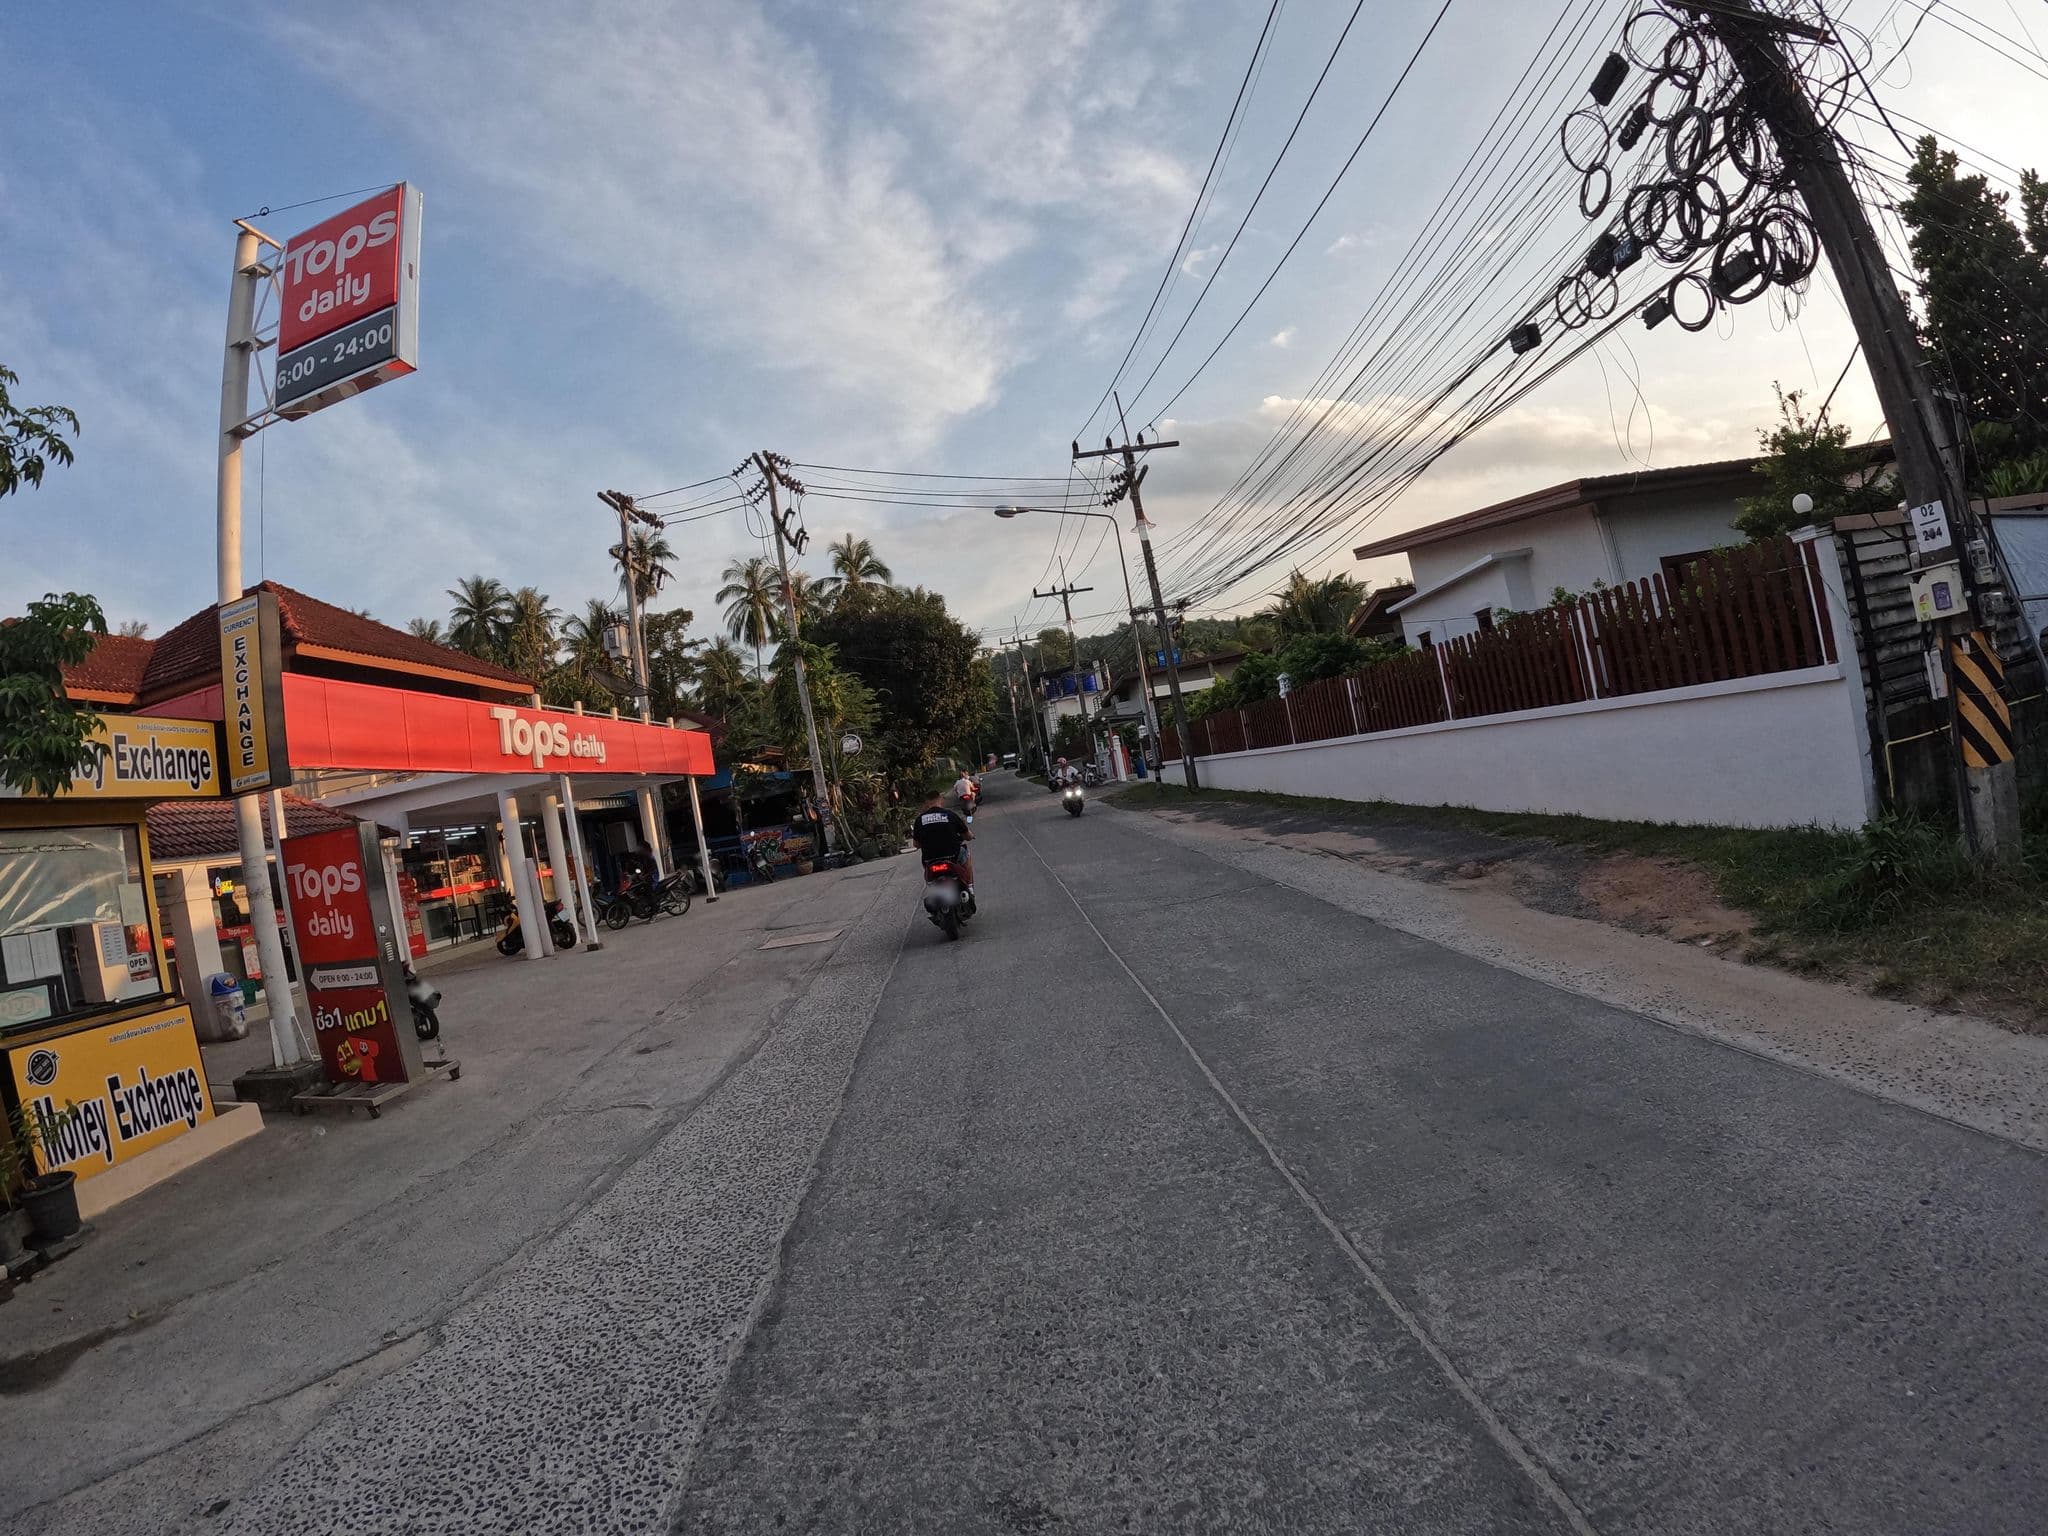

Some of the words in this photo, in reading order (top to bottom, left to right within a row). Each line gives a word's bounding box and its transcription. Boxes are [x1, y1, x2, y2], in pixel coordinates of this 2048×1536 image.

[287, 210, 397, 286] Tops
[299, 272, 370, 322] daily
[277, 355, 315, 390] 6:00
[334, 324, 392, 364] 24:00
[1921, 504, 1935, 517] 02
[224, 616, 256, 633] CURRENCY
[234, 637, 255, 767] EXCHANGE
[114, 735, 211, 789] Exchange
[490, 707, 570, 768] Tops
[572, 733, 606, 763] daily
[287, 862, 360, 905] Tops
[308, 909, 354, 940] daily
[130, 957, 147, 969] OPEN
[319, 974, 335, 983] OPEN
[108, 1067, 203, 1140] Exchange
